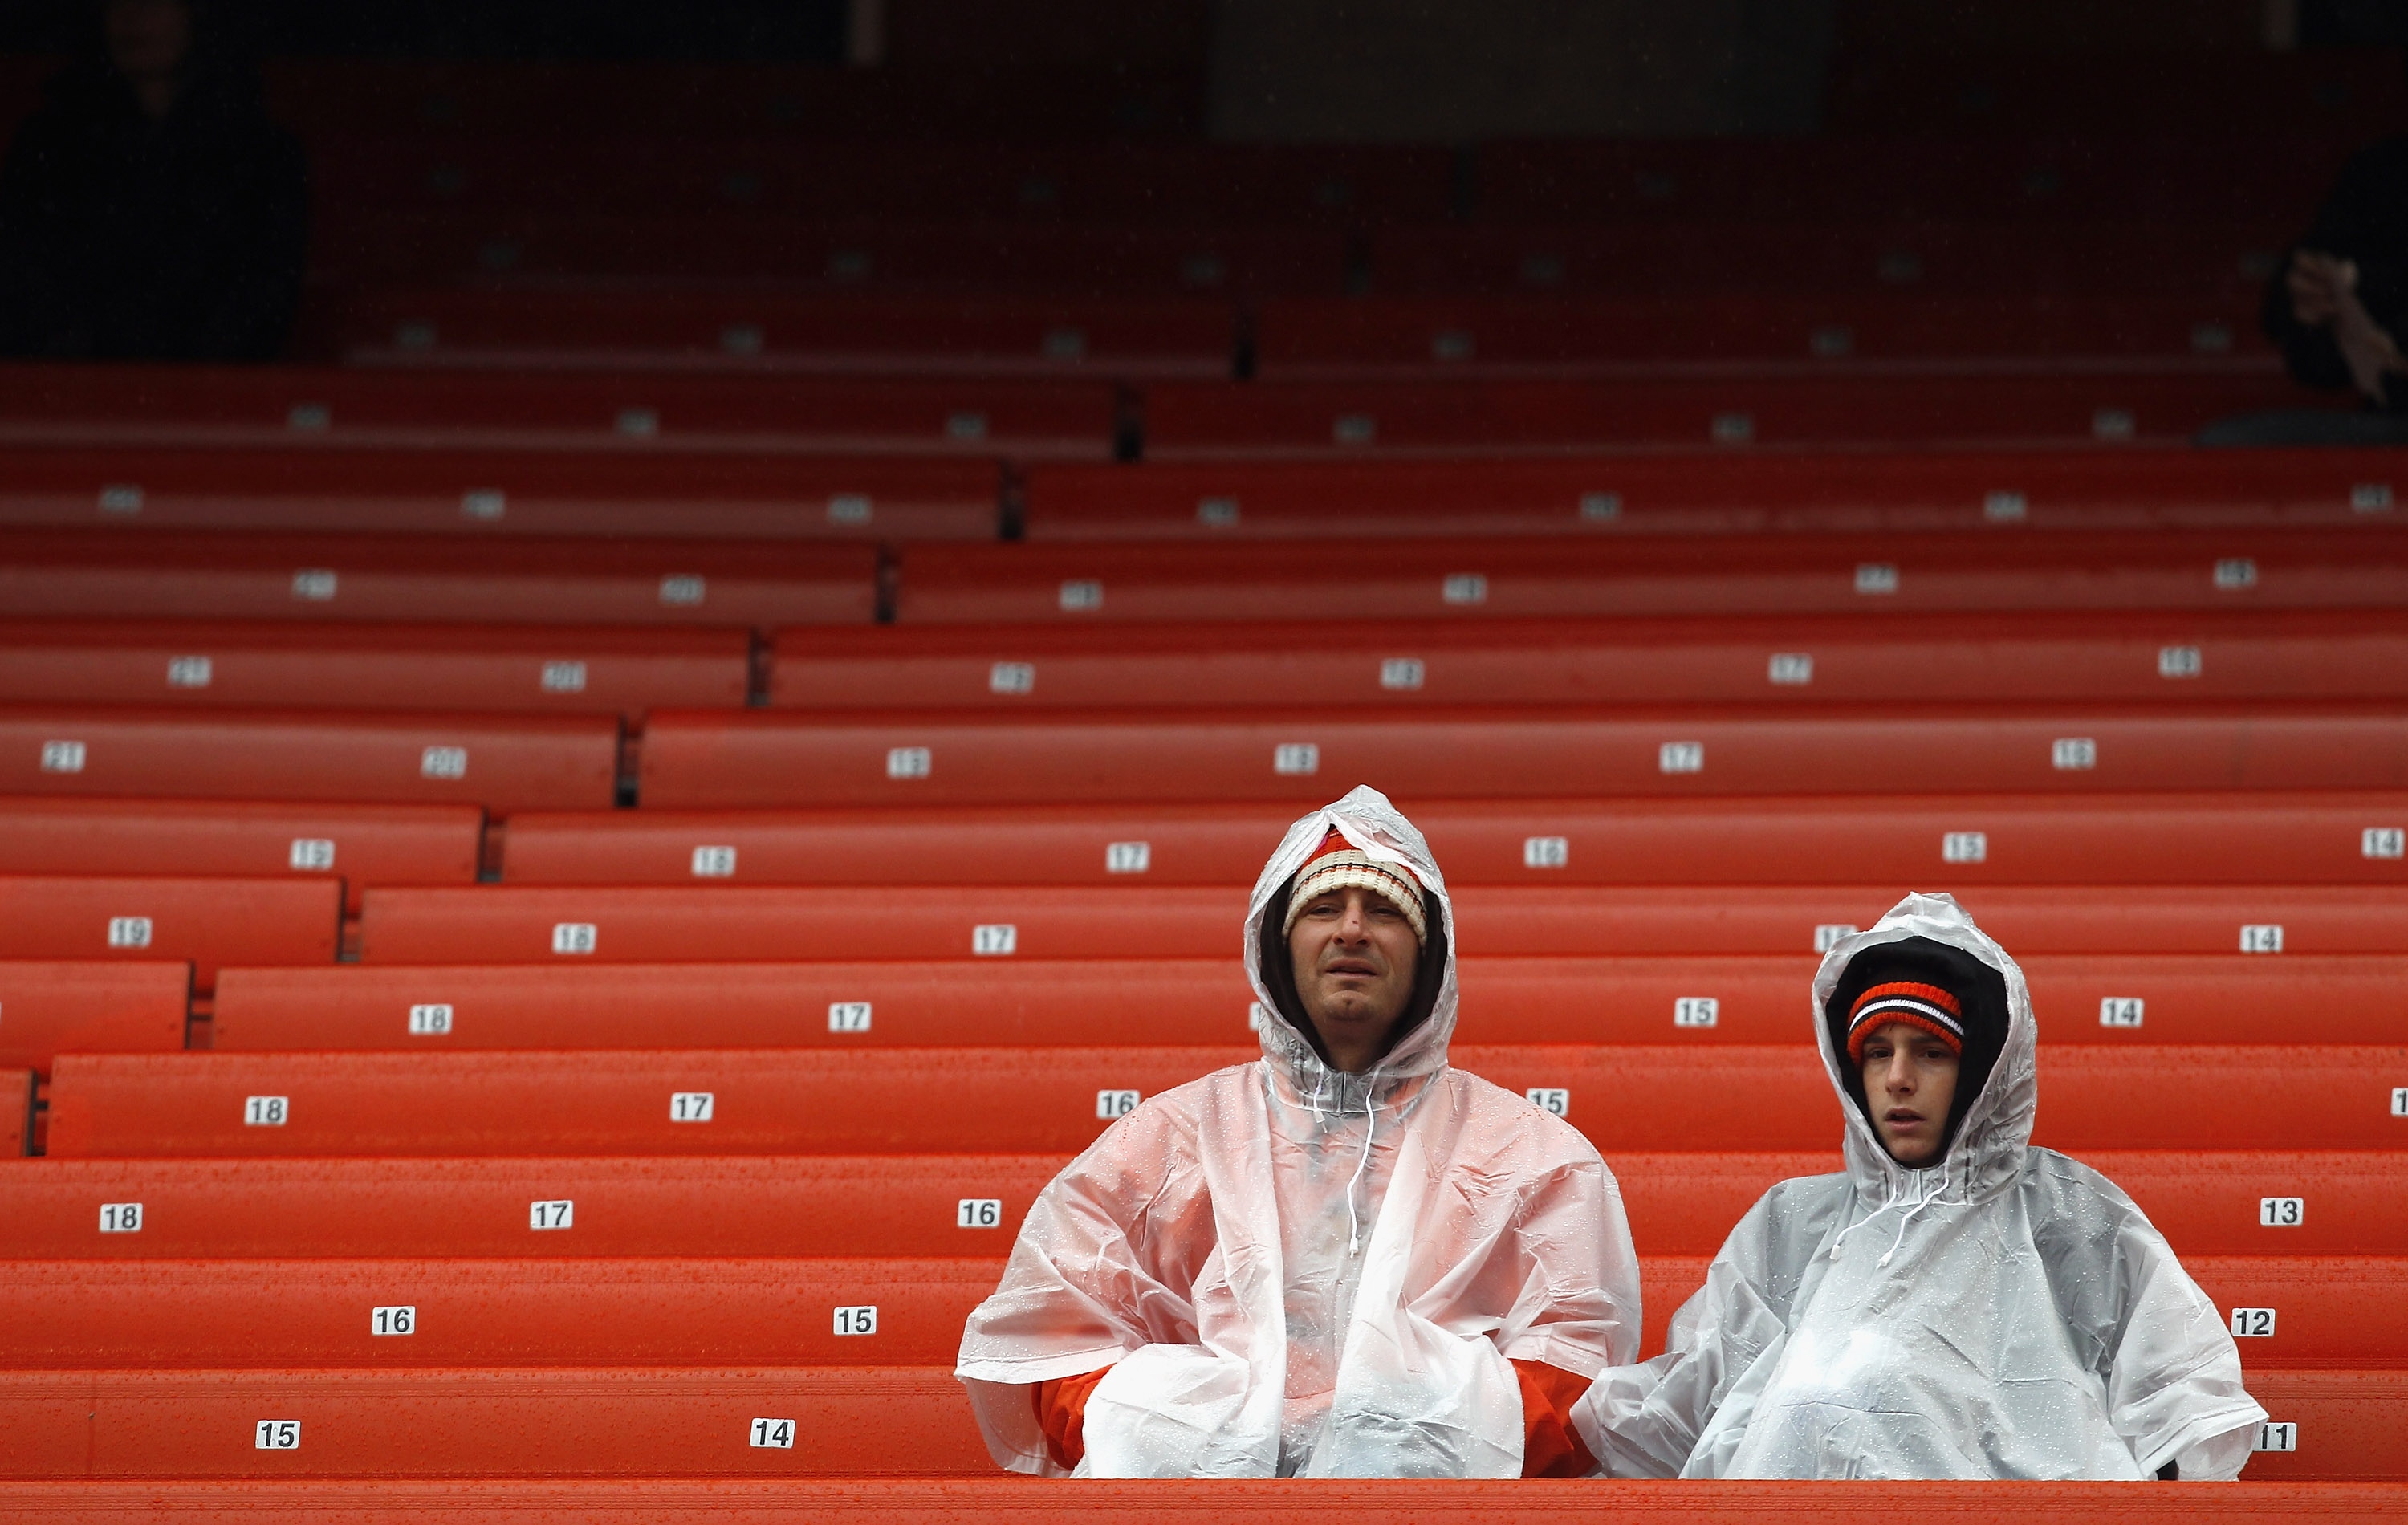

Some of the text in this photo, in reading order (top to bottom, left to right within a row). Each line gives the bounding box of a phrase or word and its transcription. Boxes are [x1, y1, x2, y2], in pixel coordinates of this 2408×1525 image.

[2369, 832, 2399, 854] 14
[1113, 845, 1144, 868] 17
[116, 921, 146, 943] 19
[981, 928, 1011, 950] 17
[2247, 928, 2276, 950] 14
[417, 1007, 446, 1031] 18
[836, 1005, 866, 1028] 17
[1682, 1000, 1711, 1023] 15
[2107, 1000, 2137, 1023] 14
[252, 1099, 282, 1121] 18
[677, 1095, 707, 1118] 17
[1102, 1092, 1133, 1115] 16
[1531, 1090, 1562, 1113] 15
[105, 1206, 137, 1229] 18
[536, 1202, 568, 1226] 17
[963, 1202, 995, 1226] 16
[2265, 1200, 2298, 1223] 13
[377, 1308, 410, 1332] 16
[838, 1308, 872, 1332] 15
[2235, 1311, 2270, 1336] 12
[261, 1422, 295, 1446] 15
[755, 1420, 791, 1446] 14
[2262, 1425, 2288, 1450] 11
